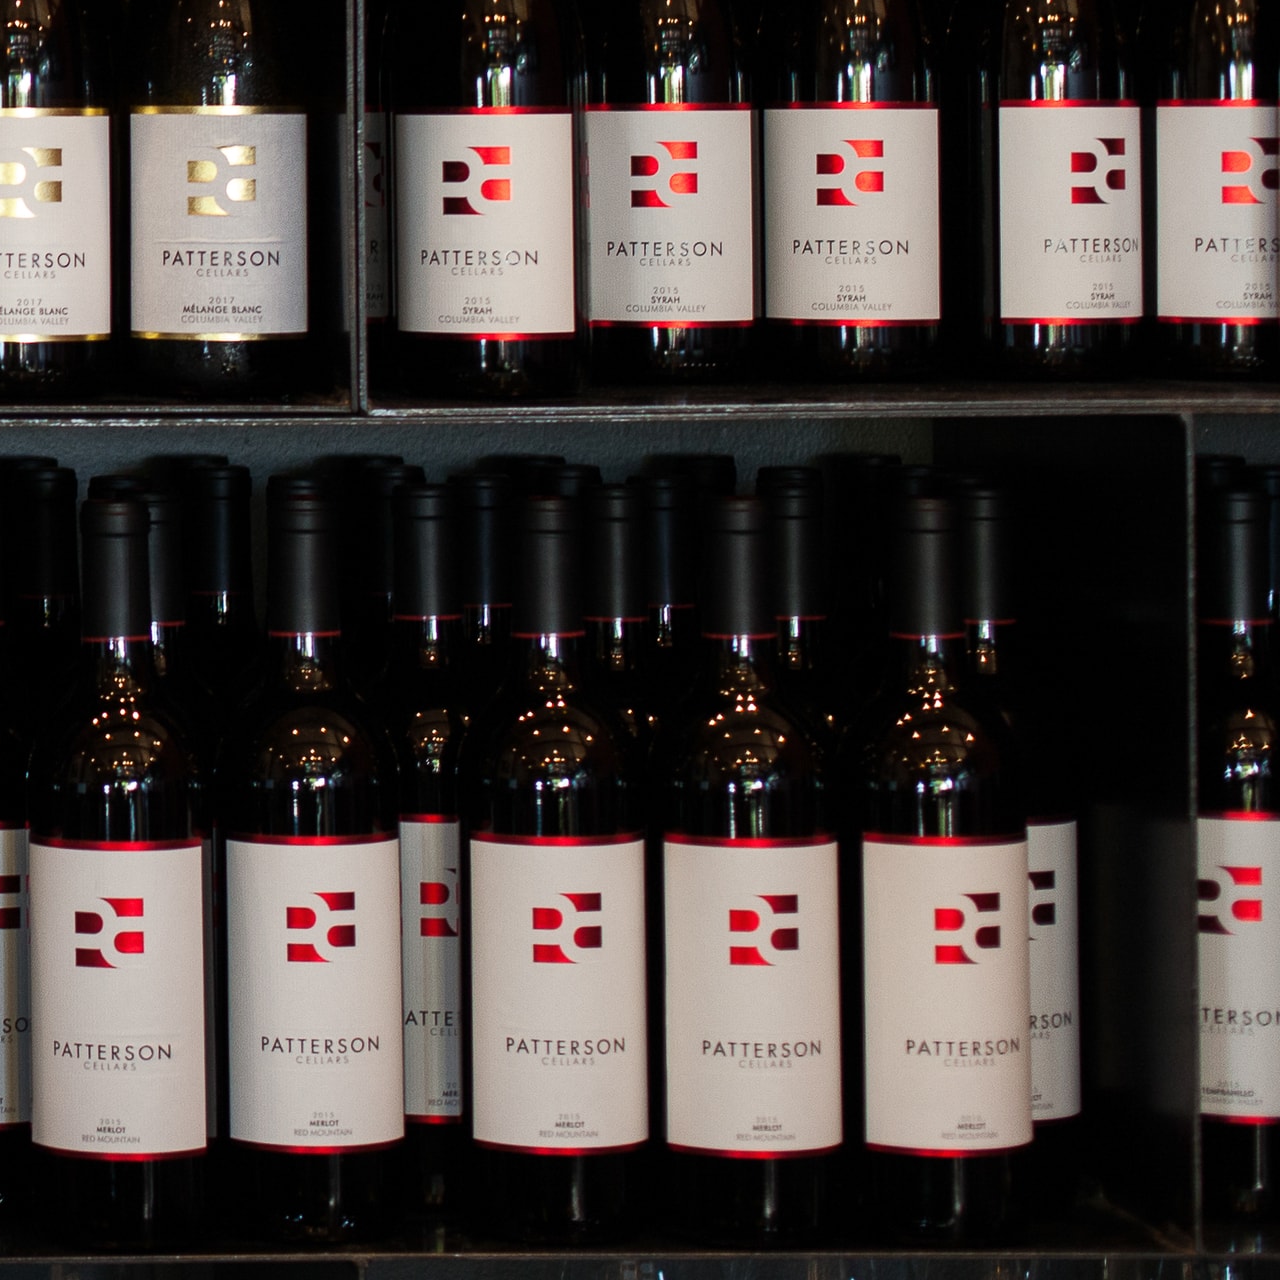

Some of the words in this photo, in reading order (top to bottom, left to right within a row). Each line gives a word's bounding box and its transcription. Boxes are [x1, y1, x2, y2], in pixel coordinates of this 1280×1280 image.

[607, 241, 723, 257] PATTERSON
[792, 240, 909, 256] PATTERSON
[1044, 238, 1139, 254] PATTERSON
[163, 250, 280, 266] PATTERSON
[421, 250, 538, 266] PATTERSON
[639, 258, 691, 267] CELLARS
[825, 257, 877, 265] CELLARS
[1080, 254, 1122, 263] CELLARS
[4, 270, 56, 279] CELLARS
[196, 269, 248, 277] CELLARS
[451, 267, 503, 276] CELLARS
[651, 296, 680, 304] SYRAH
[837, 294, 866, 302] SYRAH
[183, 303, 228, 313] MÉLANGE
[462, 307, 492, 315] SYRAH
[53, 1040, 172, 1061] PATTERSON
[261, 1036, 379, 1055] PATTERSON
[506, 1037, 625, 1057] PATTERSON
[703, 1040, 821, 1059] PATTERSON
[906, 1037, 1020, 1057] PATTERSON
[296, 1055, 349, 1065] CELLARS
[83, 1061, 137, 1072] CELLARS
